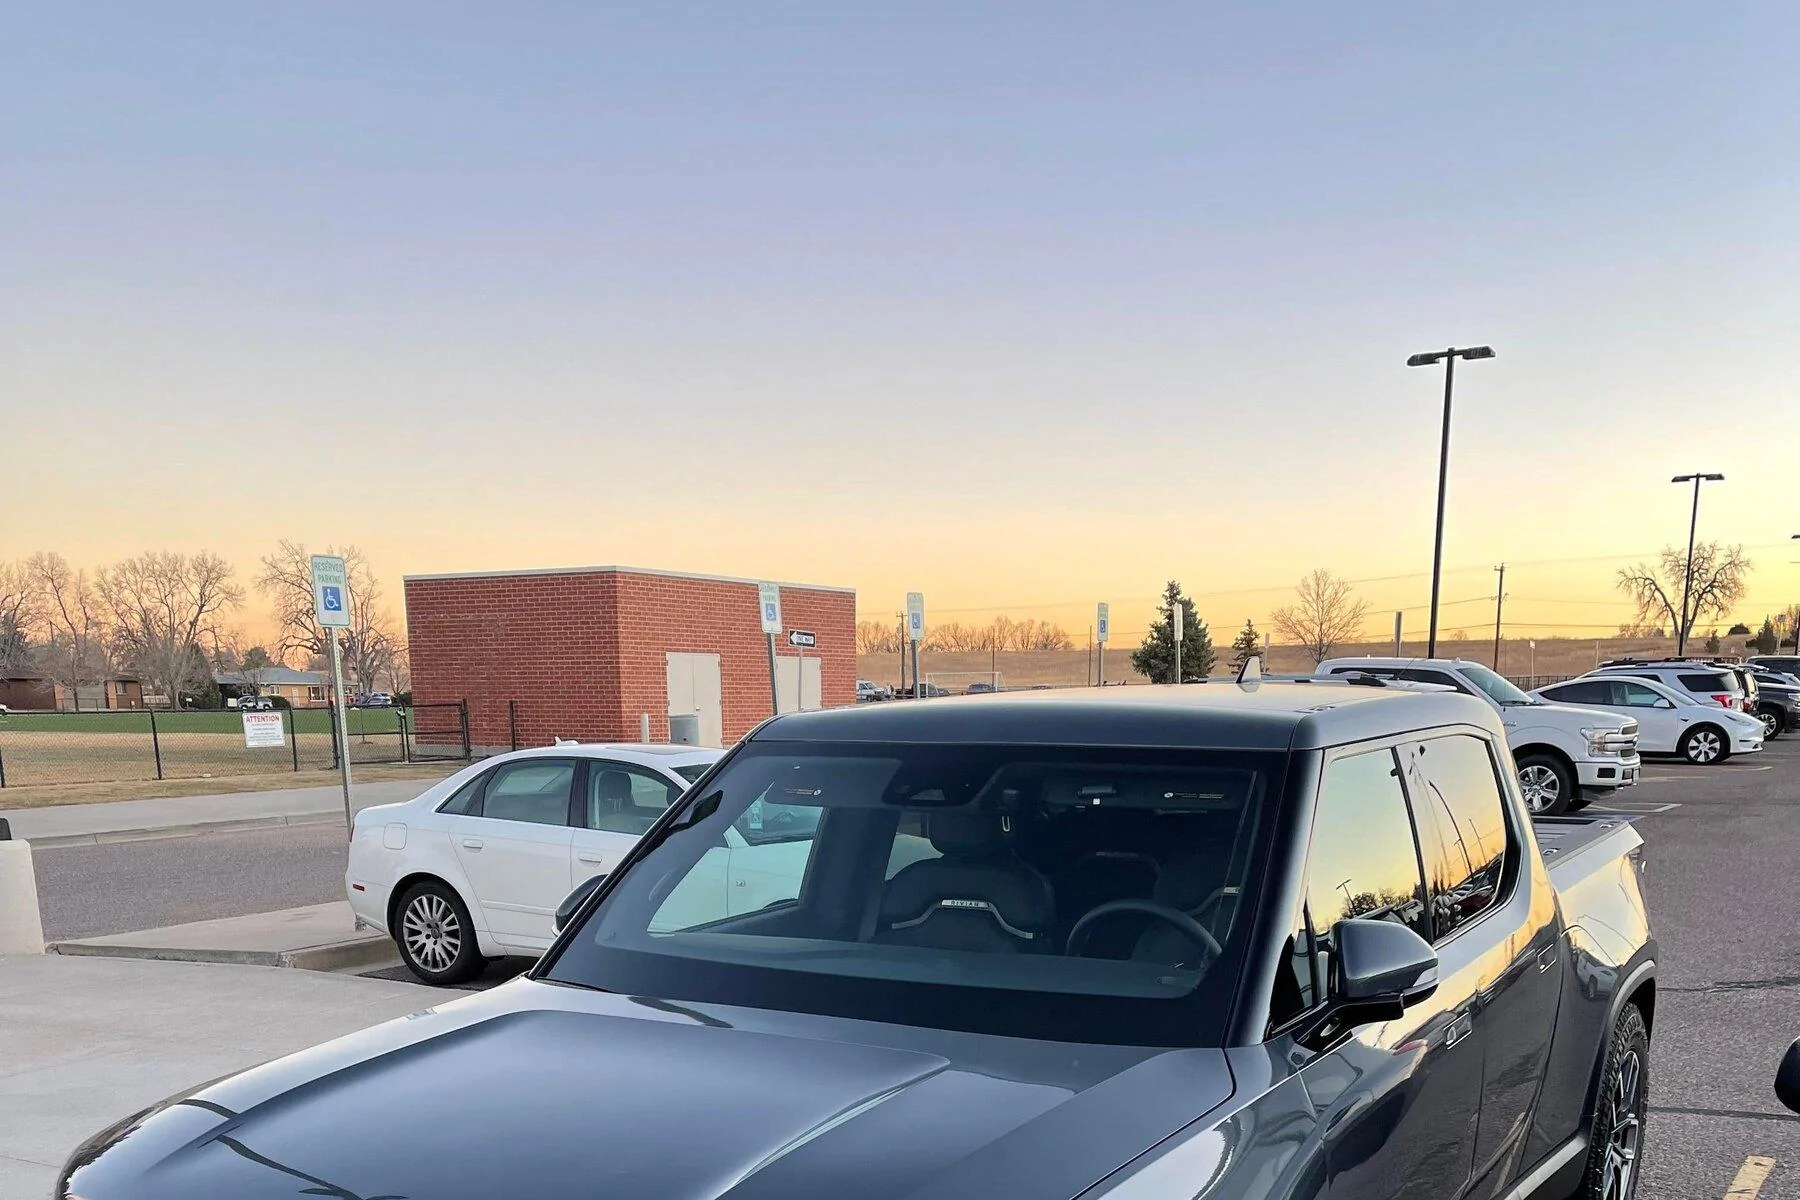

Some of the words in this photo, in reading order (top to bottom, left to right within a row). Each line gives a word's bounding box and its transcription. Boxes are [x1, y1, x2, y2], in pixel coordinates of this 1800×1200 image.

[313, 560, 344, 573] RESERVED
[317, 573, 342, 584] PARKING
[245, 714, 280, 723] ATTENTION
